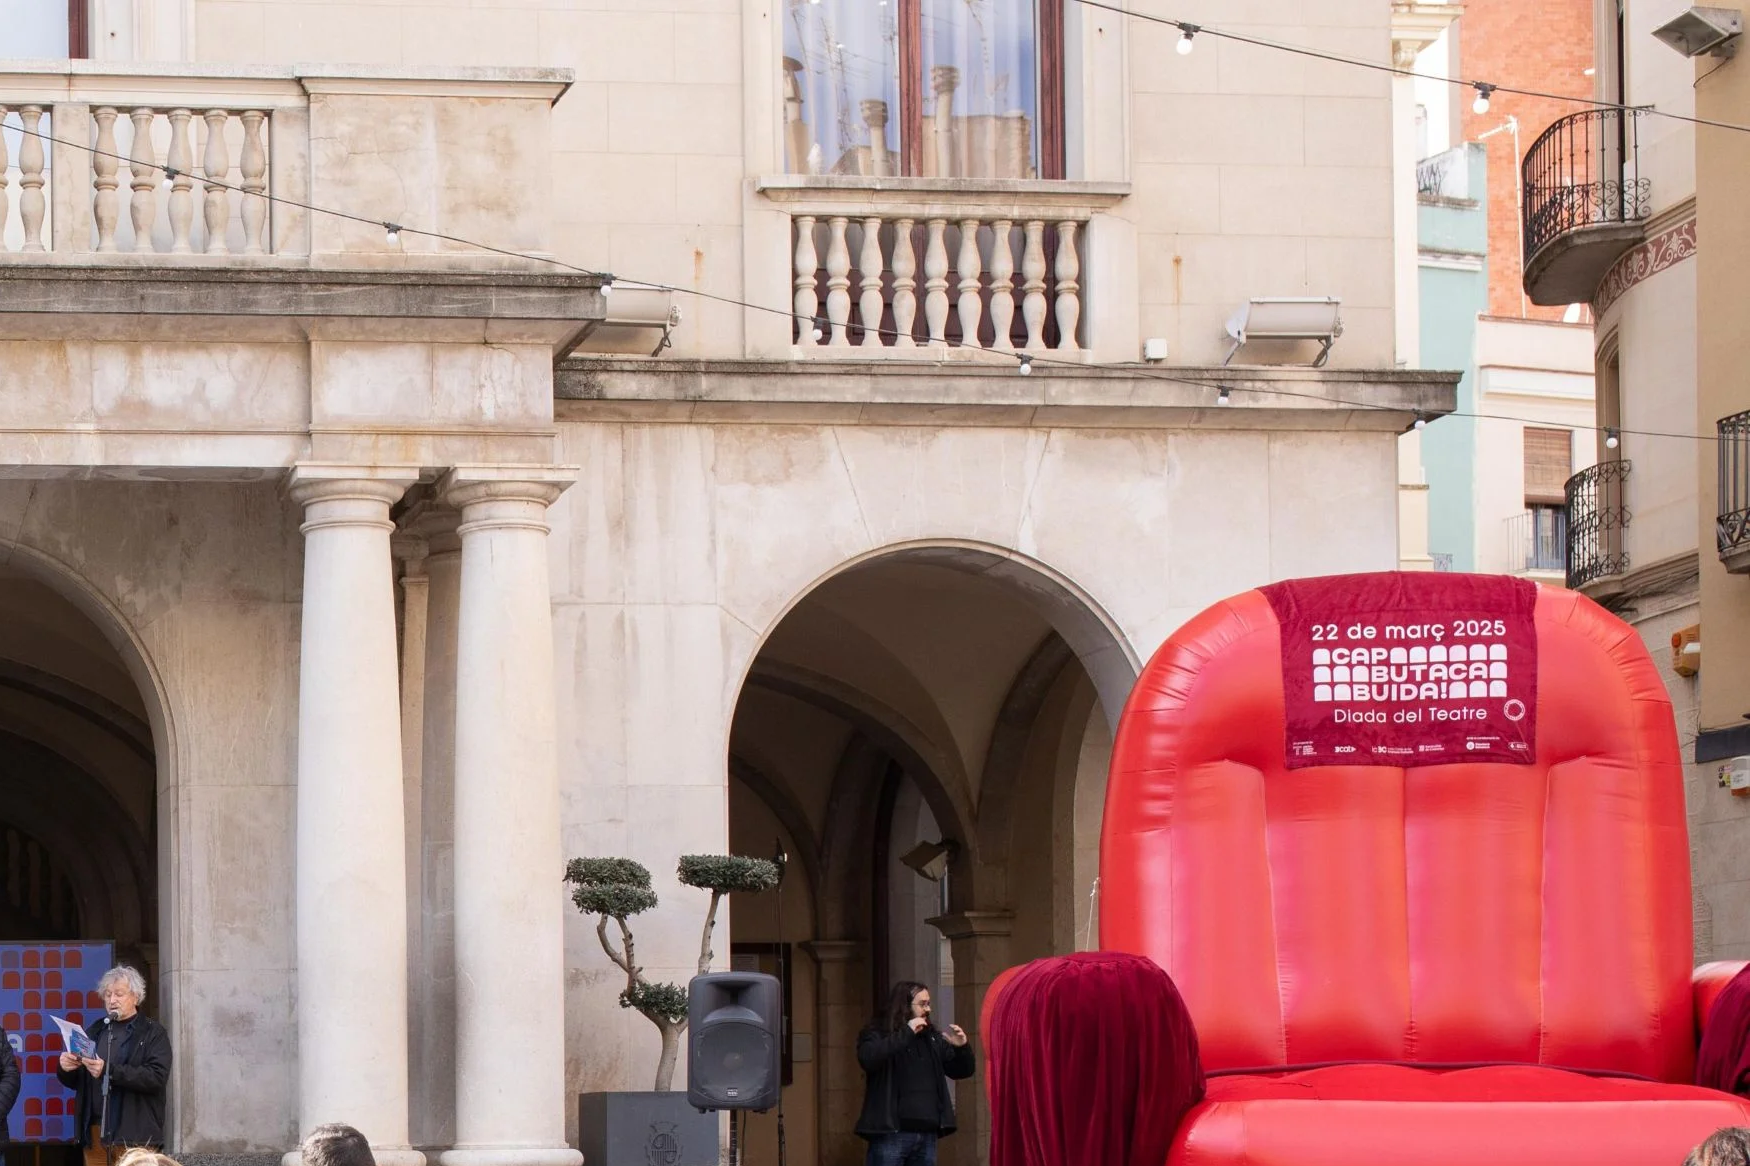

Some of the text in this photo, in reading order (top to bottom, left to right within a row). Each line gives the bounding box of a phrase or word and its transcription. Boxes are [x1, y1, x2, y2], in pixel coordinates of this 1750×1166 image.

[1311, 619, 1507, 642] 22 de març 2025
[1331, 647, 1389, 665] CAP
[1371, 662, 1488, 682] BUTACA
[1352, 681, 1448, 702] BUIDA!
[1334, 708, 1387, 723] Diada
[1393, 708, 1422, 722] del
[1428, 706, 1488, 721] Teatre
